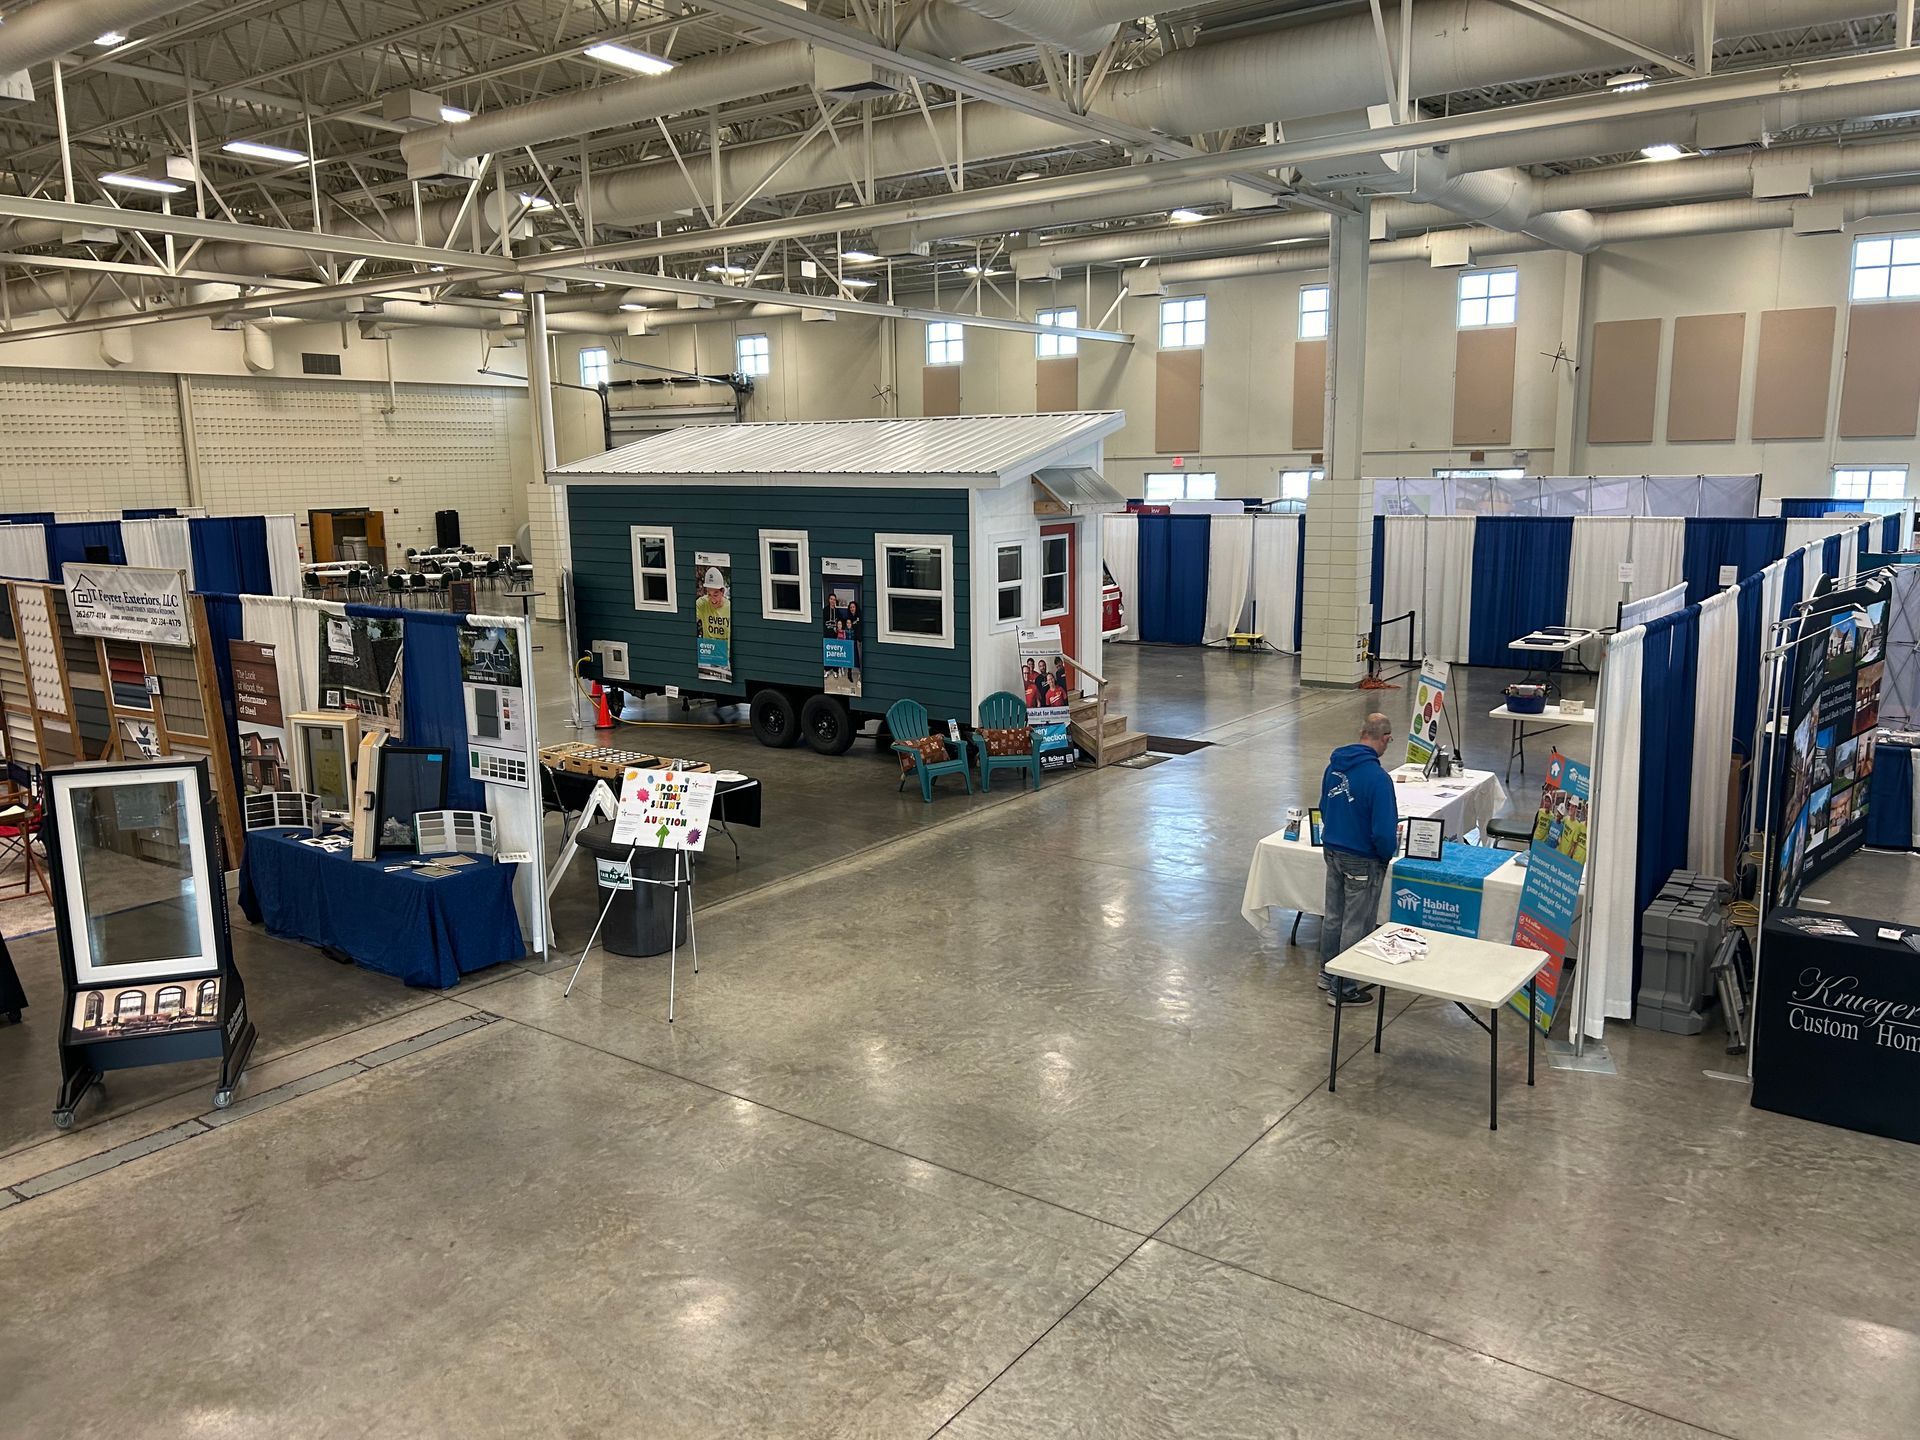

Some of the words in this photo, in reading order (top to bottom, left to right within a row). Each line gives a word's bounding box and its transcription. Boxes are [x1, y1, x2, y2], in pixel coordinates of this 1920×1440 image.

[98, 590, 122, 606] Feyrer
[123, 592, 160, 608] Exteriors,
[162, 594, 179, 608] LLC
[708, 615, 729, 626] every
[708, 626, 724, 635] one
[826, 644, 843, 652] every
[245, 706, 256, 716] Steel
[1042, 708, 1050, 716] for
[655, 784, 688, 793] SPORTS
[659, 792, 681, 801] ITEMS
[650, 800, 681, 810] SILENT
[644, 816, 688, 827] AUCTION
[1532, 854, 1550, 868] Discover
[1423, 898, 1460, 913] Habitat
[1432, 908, 1460, 919] Humanity
[1792, 967, 1920, 1028] Krueger
[1789, 1008, 1858, 1040] Custom
